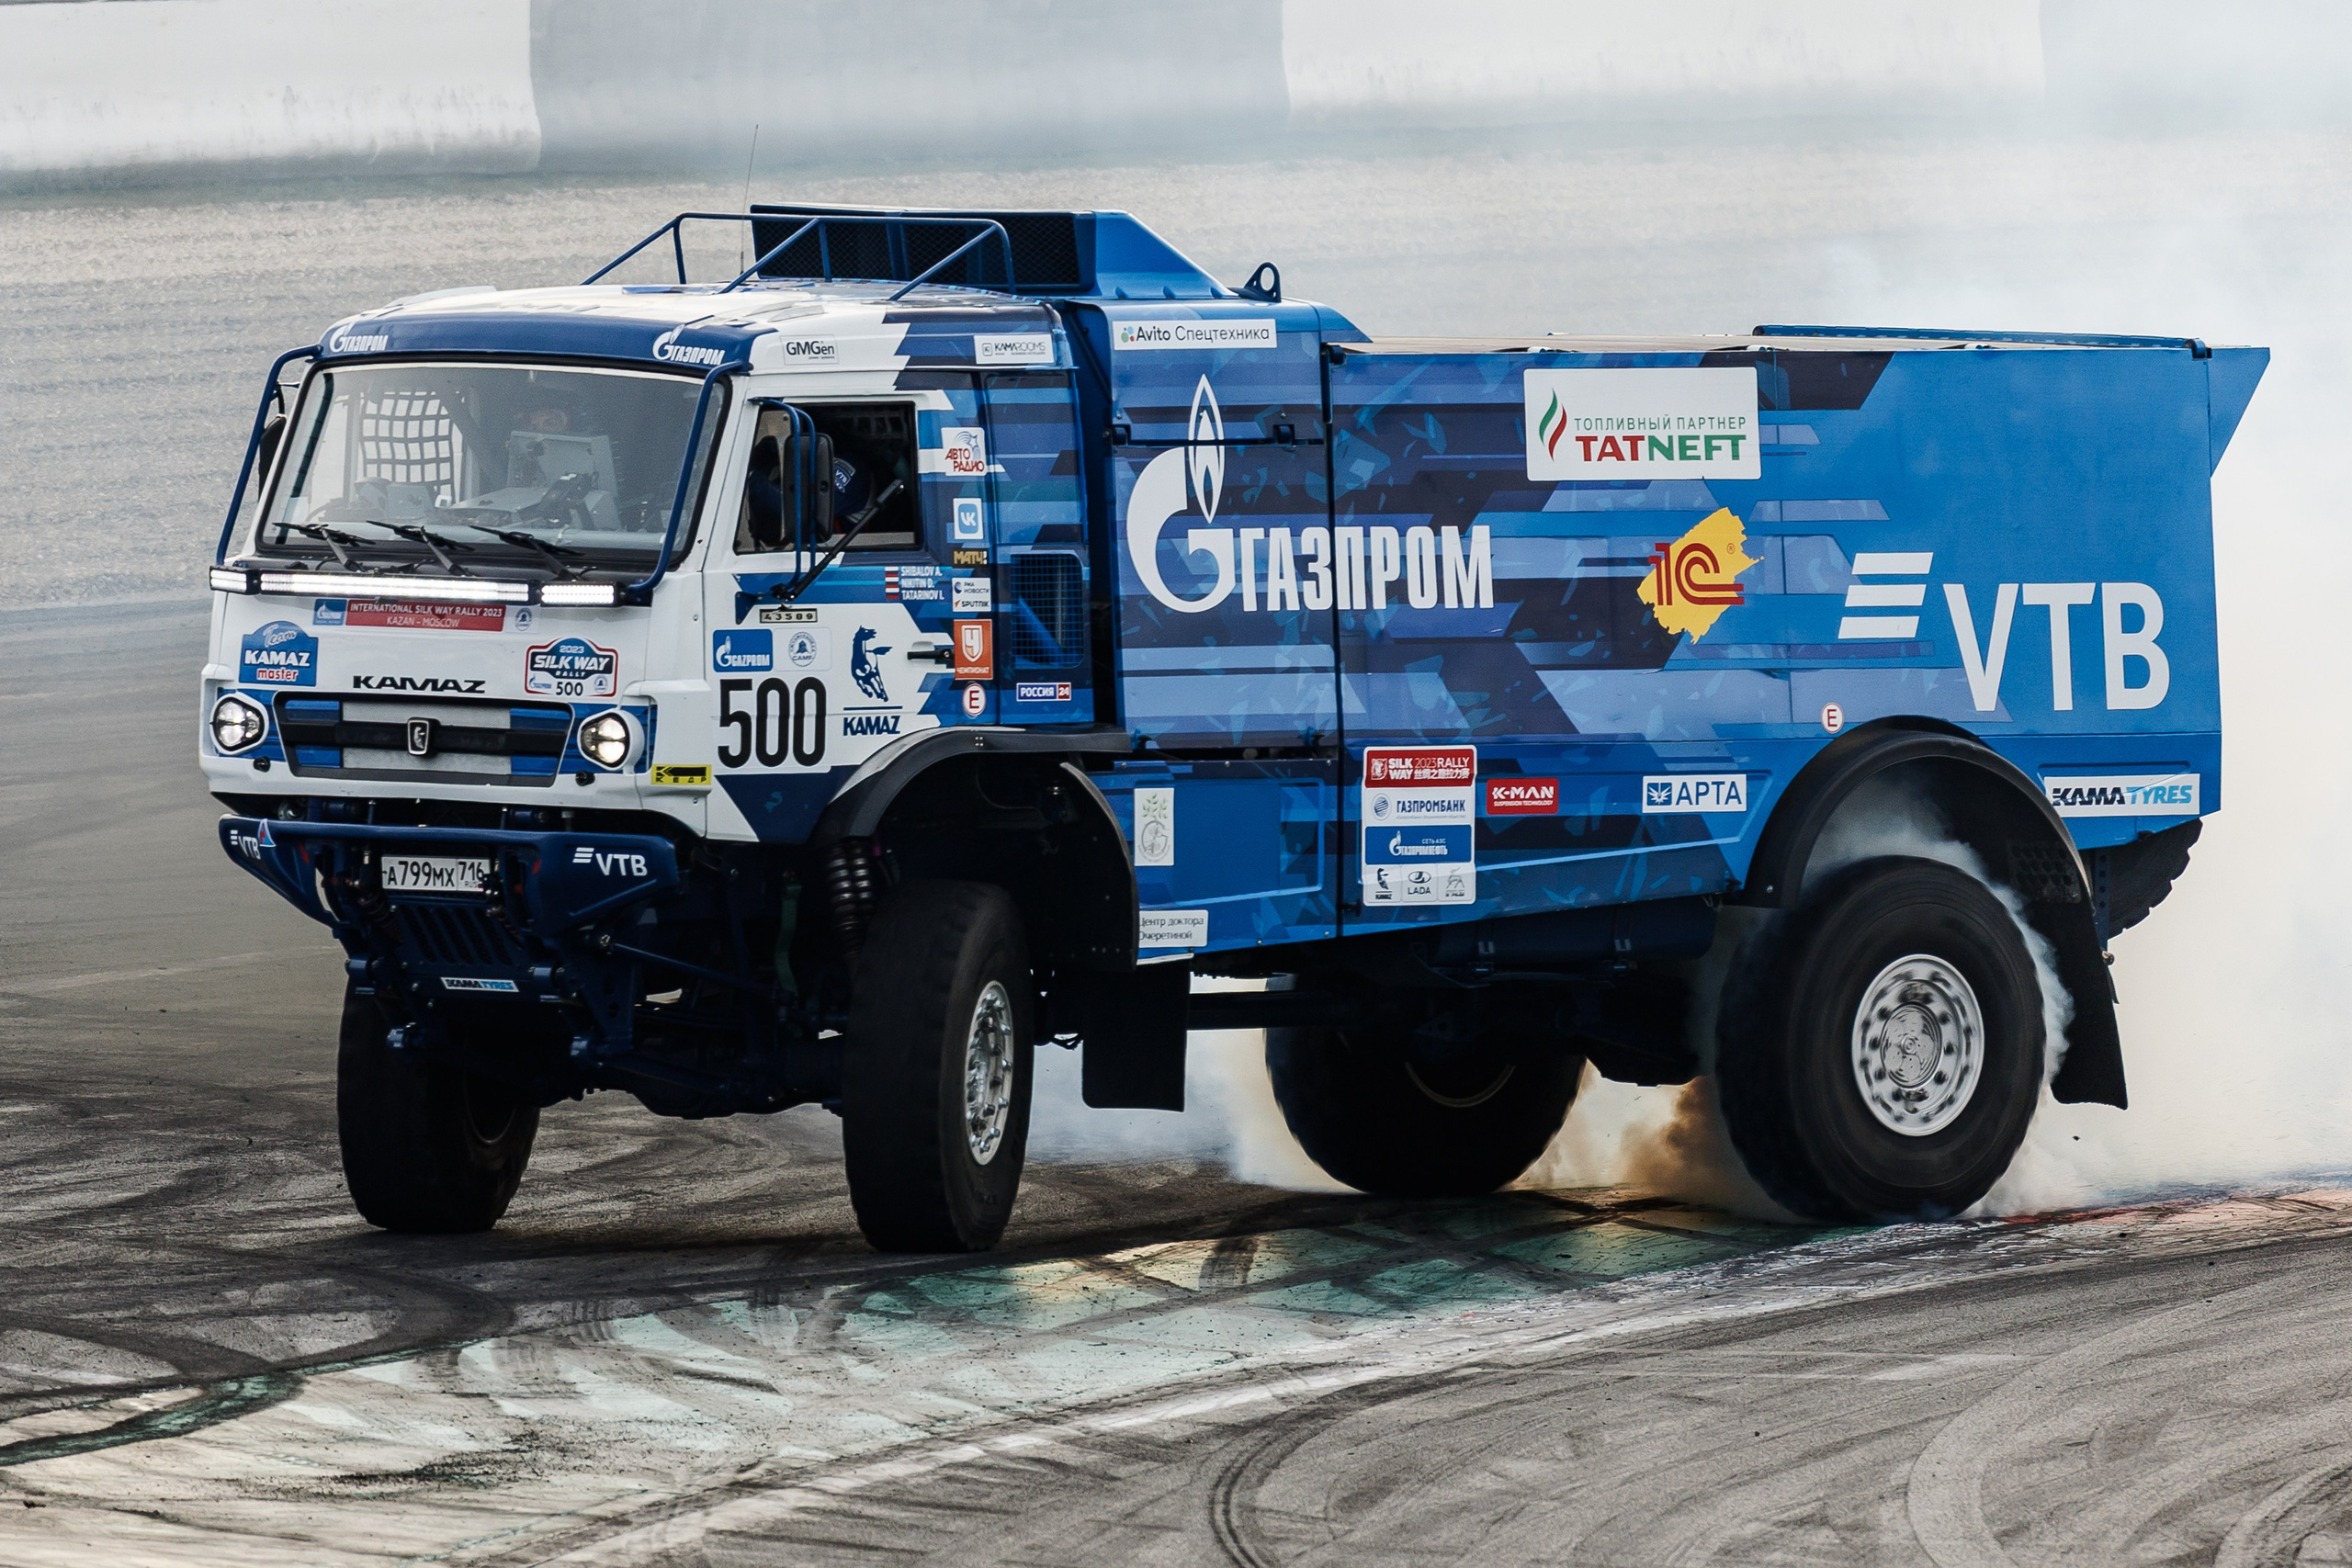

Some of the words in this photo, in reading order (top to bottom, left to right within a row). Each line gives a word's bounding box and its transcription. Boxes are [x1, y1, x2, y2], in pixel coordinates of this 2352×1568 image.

[1136, 326, 1170, 342] Avito
[1175, 325, 1270, 343] Спецтехника
[344, 335, 389, 352] ГАЗПРОМ
[786, 340, 835, 355] GMGen
[671, 344, 726, 366] ГАЗПРОМ
[1574, 414, 1671, 431] ТОПЛИВНЫЙ
[1677, 416, 1747, 430] ПАРТНЕР
[945, 448, 971, 460] АВТО
[1575, 434, 1747, 462] TATNEFT
[953, 461, 985, 472] РАДИО
[960, 512, 977, 526] VK
[954, 551, 988, 565] МАТЧ!
[901, 566, 934, 576] SHIBALOV
[1239, 525, 1494, 612] ГАЗПРОМ
[901, 578, 926, 588] NIKITIN
[901, 590, 938, 600] TATARINOV
[350, 603, 413, 614] INTERNATIONAL
[414, 604, 434, 615] SILK
[435, 606, 454, 615] WAY
[455, 607, 481, 616] RALLY
[482, 608, 503, 617] 2023
[386, 616, 415, 626] KAZAN
[422, 617, 461, 627] MOSCOW
[263, 624, 297, 648] Team
[560, 645, 584, 654] 2023
[1942, 582, 2171, 712] VTB
[244, 649, 311, 667] KAMAZ
[533, 655, 573, 670] SILK
[574, 656, 610, 671] WAY
[731, 654, 770, 667] GAZPROM
[257, 668, 299, 682] master
[353, 675, 486, 694] KAMAZ
[556, 682, 583, 696] 500
[969, 690, 979, 708] E
[1021, 687, 1054, 697] РОССИЯ
[1058, 687, 1069, 696] 24
[718, 676, 826, 768] 500
[1826, 708, 1838, 728] E
[842, 715, 900, 736] KAMAZ
[1388, 758, 1413, 769] SILK
[1415, 758, 1437, 769] 2023
[1437, 757, 1470, 768] RALLY
[1388, 769, 1413, 780] WAY
[1492, 785, 1555, 799] K-MAN
[1675, 781, 1743, 807] АРТА
[1396, 799, 1466, 813] ГАЗПРОМБАНК
[238, 836, 261, 860] VTB
[458, 862, 484, 880] 716
[595, 853, 648, 876] VTB
[1408, 886, 1431, 895] LADA
[1168, 918, 1204, 928] доктора
